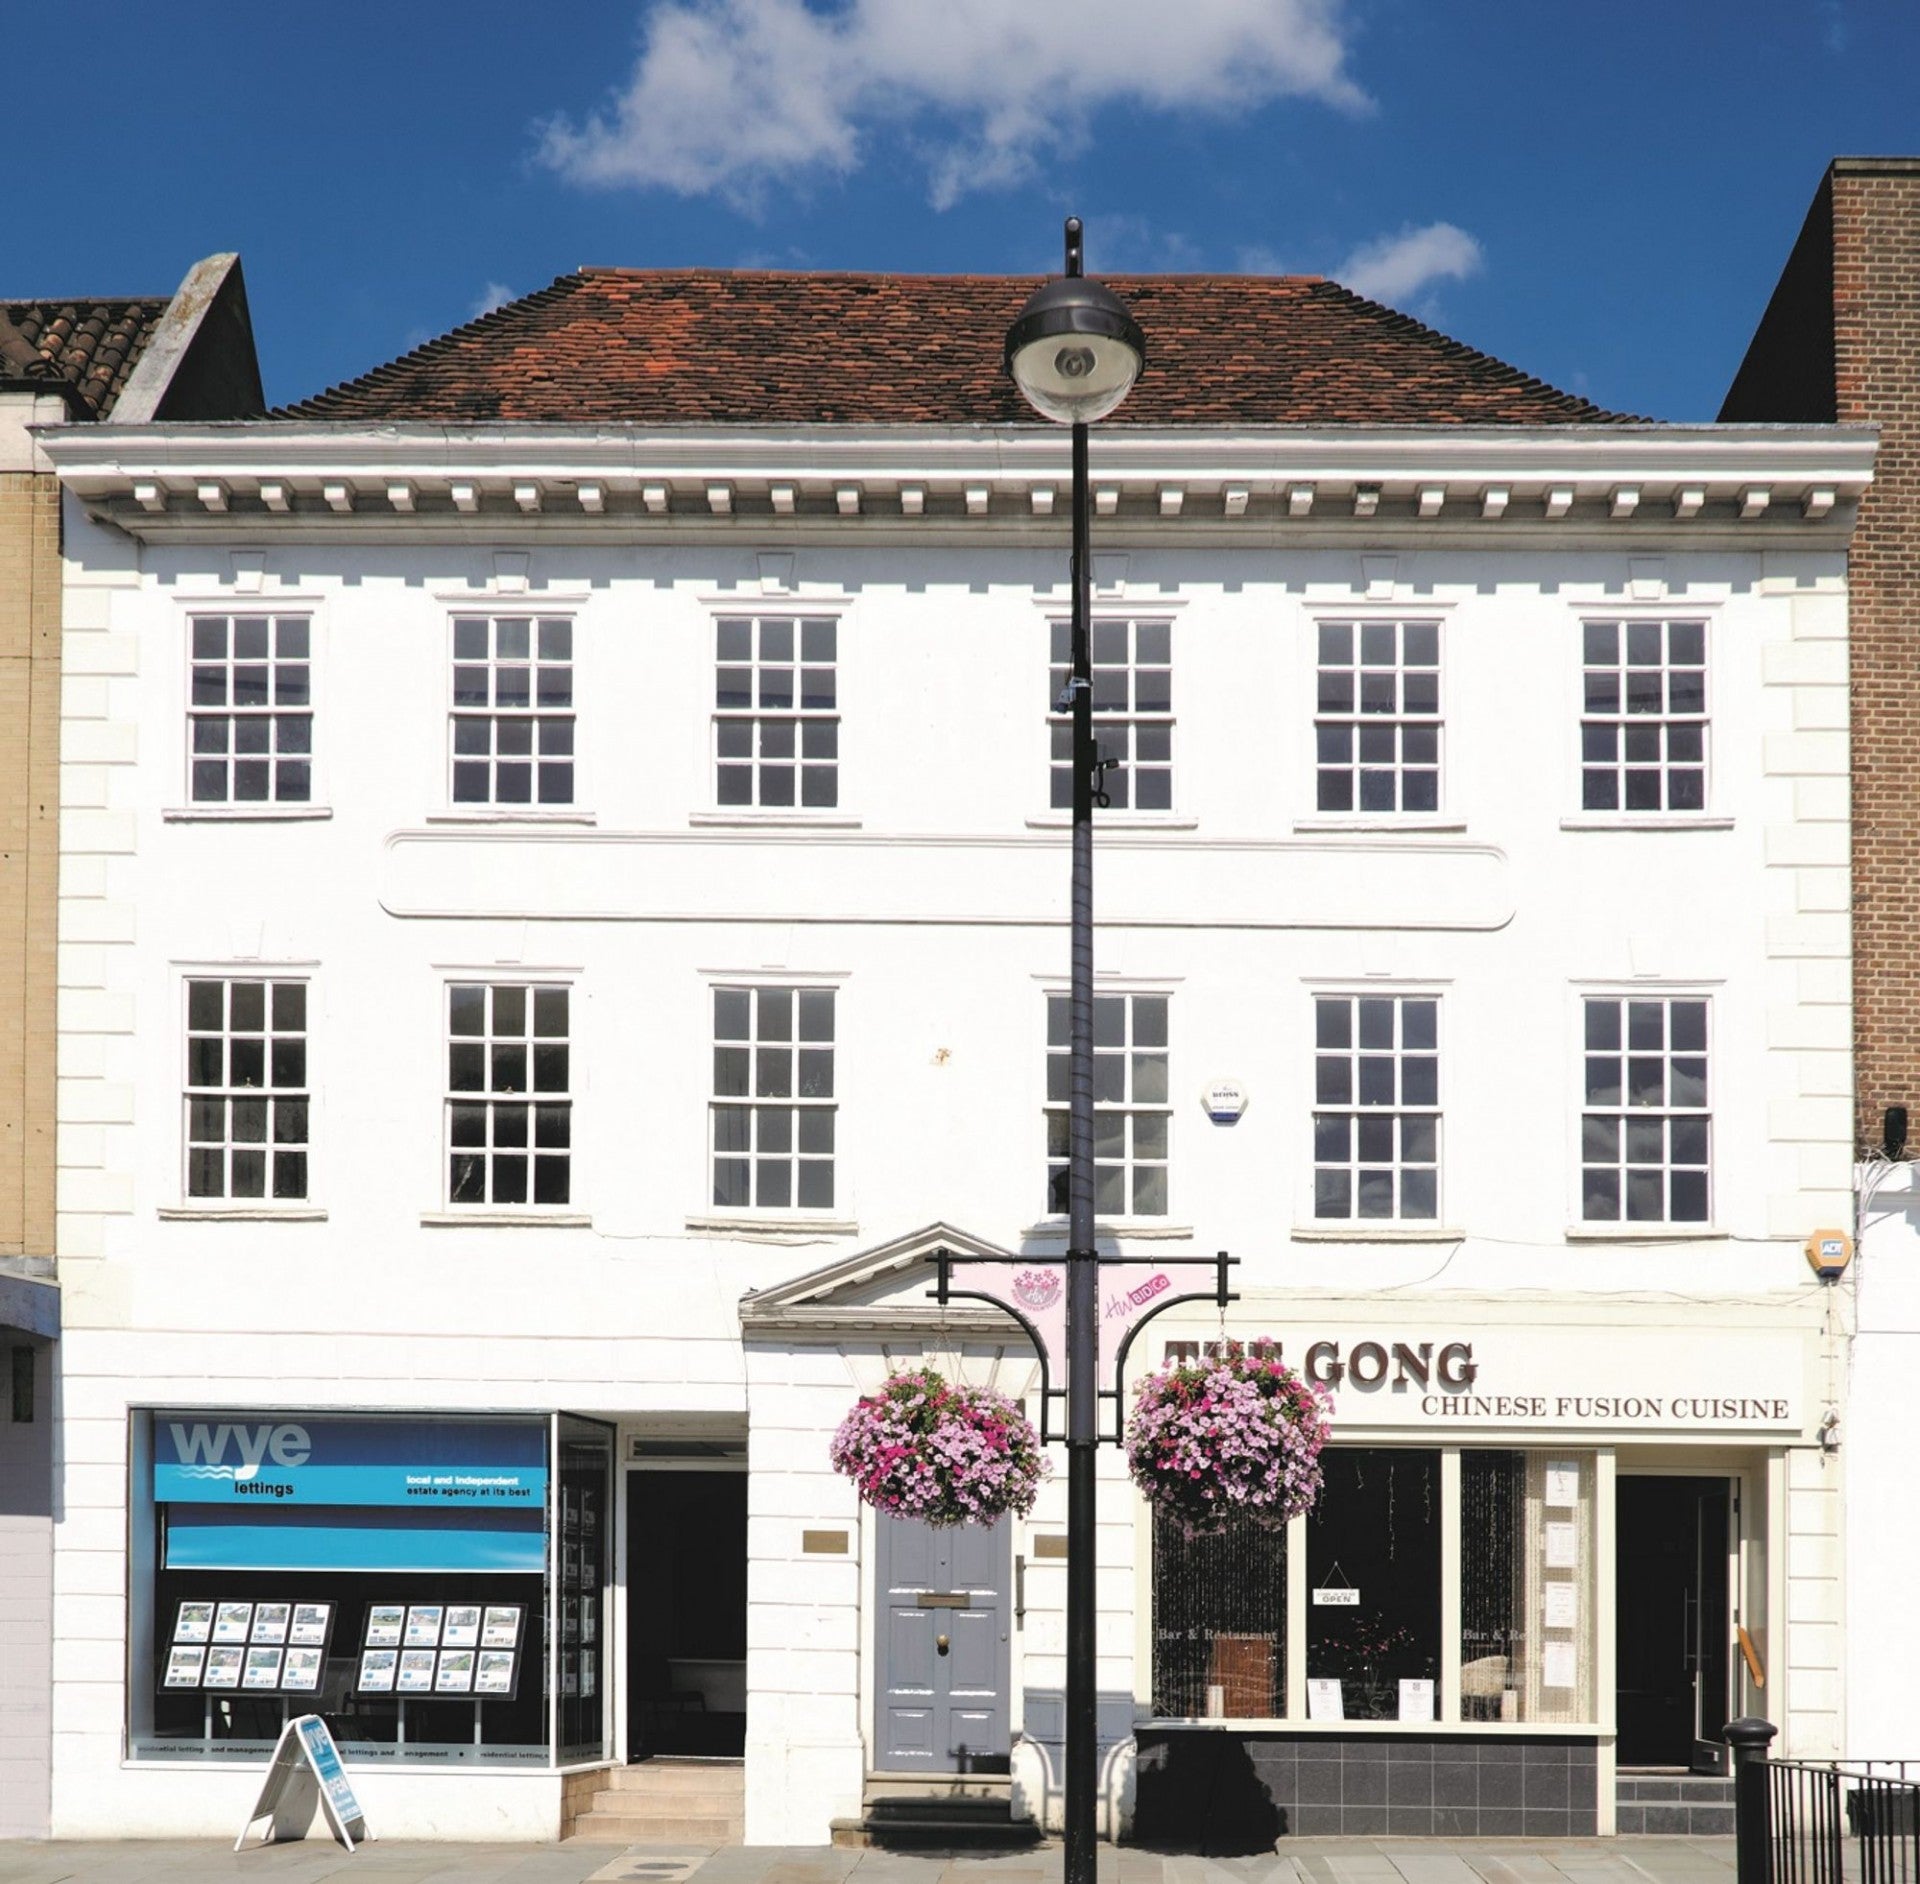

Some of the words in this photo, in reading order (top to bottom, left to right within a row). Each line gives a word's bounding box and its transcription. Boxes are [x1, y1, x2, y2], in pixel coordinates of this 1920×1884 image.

[1305, 1341, 1479, 1383] GONG
[1421, 1397, 1547, 1417] CHINESE
[1555, 1398, 1663, 1418] FUSION
[1671, 1399, 1790, 1420] CUISINE
[169, 1423, 311, 1480] wye
[406, 1476, 431, 1485] local
[433, 1477, 453, 1485] and
[234, 1481, 294, 1498] lettings
[406, 1487, 439, 1495] estate
[441, 1488, 478, 1497] agency
[480, 1488, 491, 1496] at
[493, 1488, 506, 1496] its
[508, 1488, 531, 1497] best
[1322, 1595, 1351, 1603] OPEN
[1158, 1627, 1182, 1640] Bar
[1187, 1627, 1199, 1641] &
[1204, 1627, 1279, 1641] Restaurant
[1462, 1628, 1487, 1641] Bar
[1492, 1628, 1504, 1641] &
